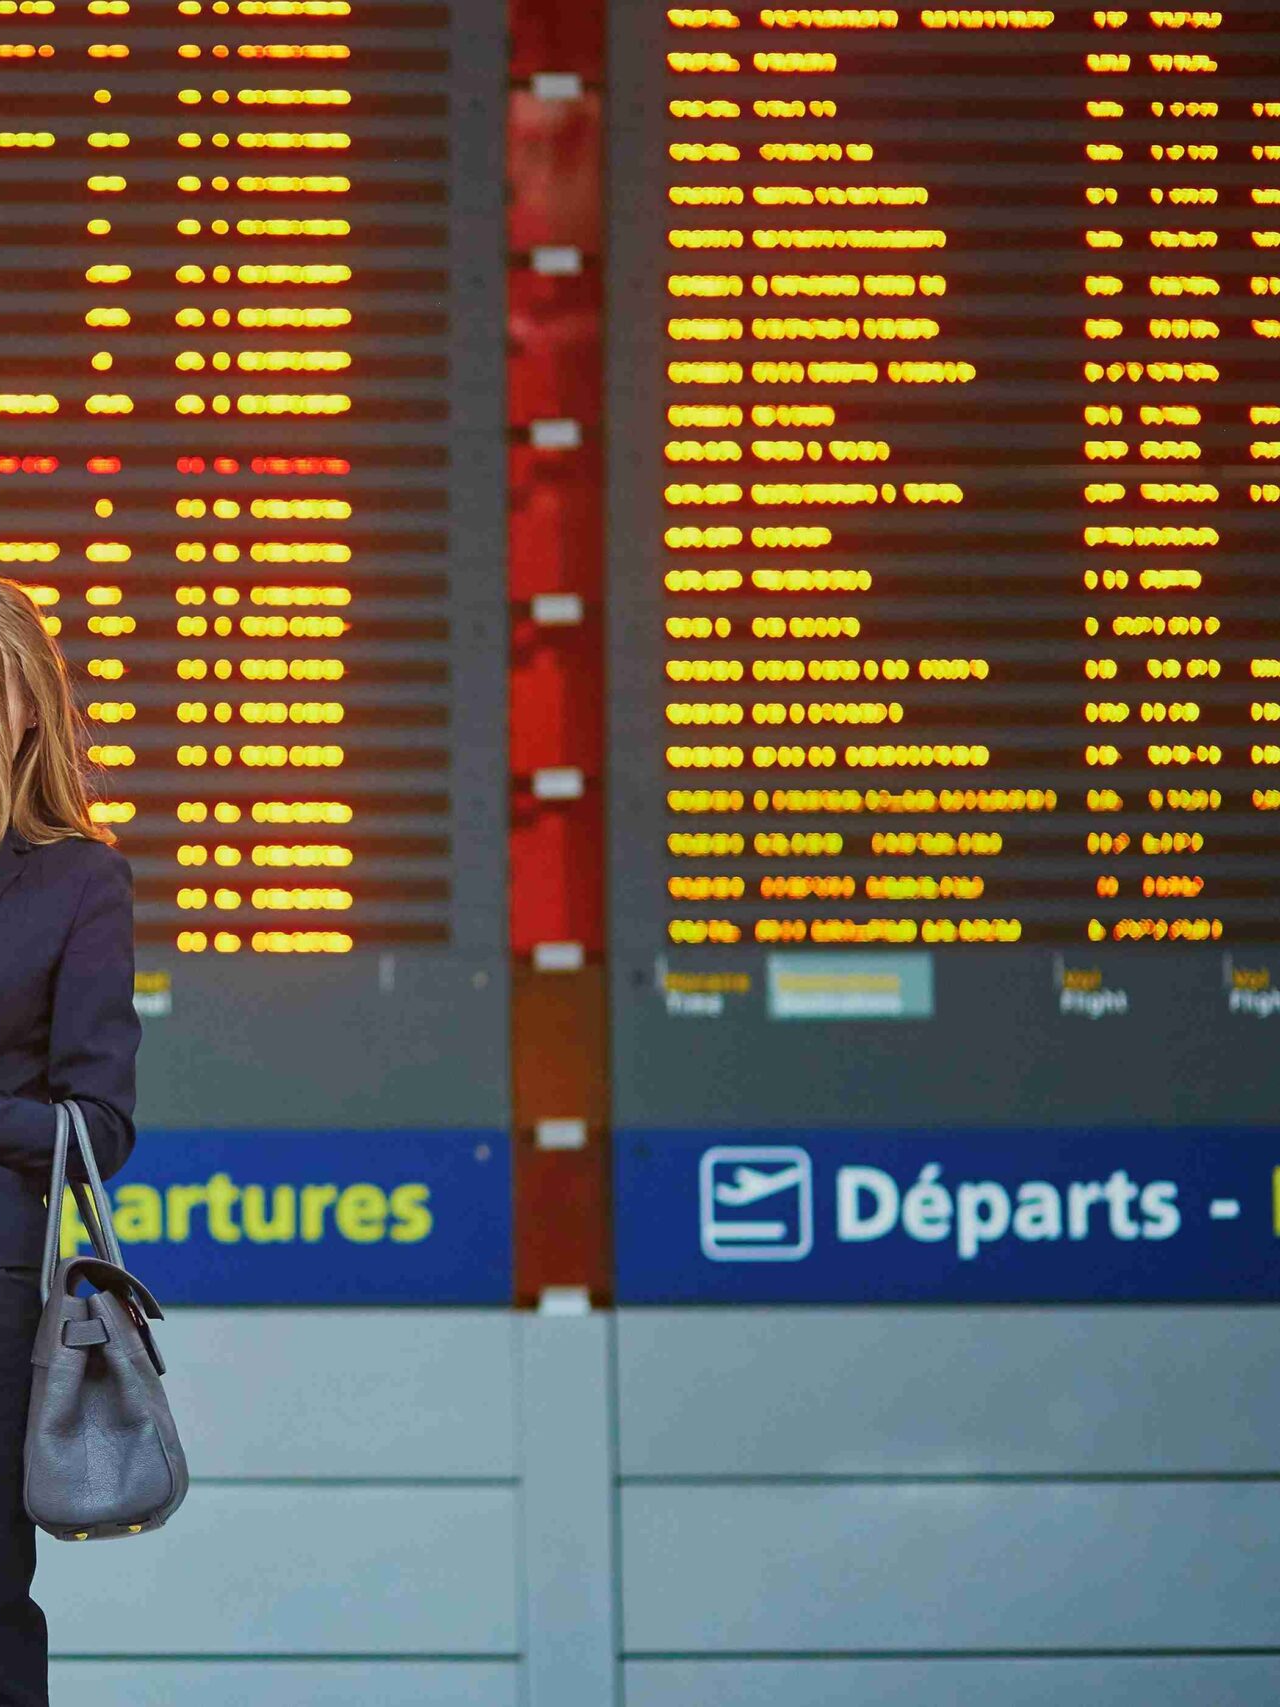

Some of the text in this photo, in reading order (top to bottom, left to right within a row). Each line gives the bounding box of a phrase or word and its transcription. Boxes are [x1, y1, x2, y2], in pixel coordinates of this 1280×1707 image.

[1229, 989, 1280, 1018] Fligh
[58, 1172, 433, 1260] partures
[836, 1163, 1181, 1260] Départs
